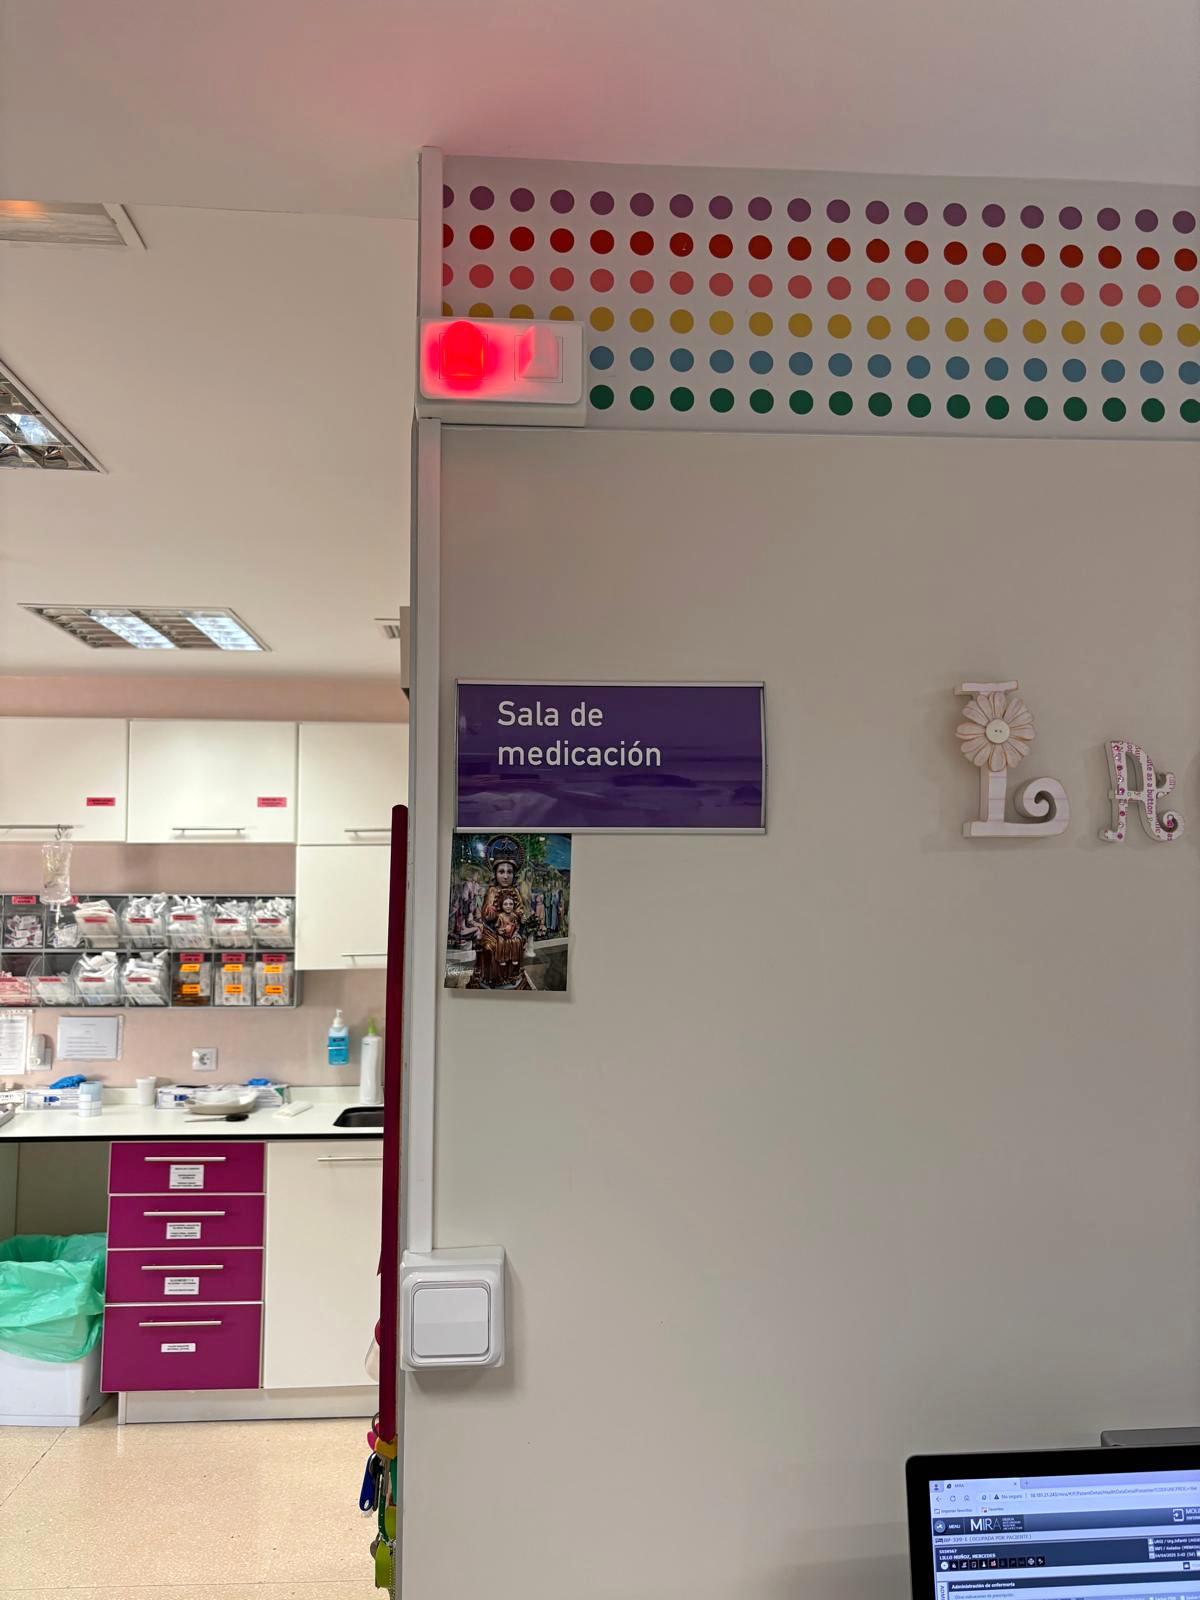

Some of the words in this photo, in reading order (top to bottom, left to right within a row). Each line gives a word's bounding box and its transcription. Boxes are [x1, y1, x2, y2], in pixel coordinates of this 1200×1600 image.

[497, 700, 559, 727] Sala
[570, 701, 604, 727] de
[498, 739, 661, 767] medicación
[970, 1518, 1001, 1532] MIRA
